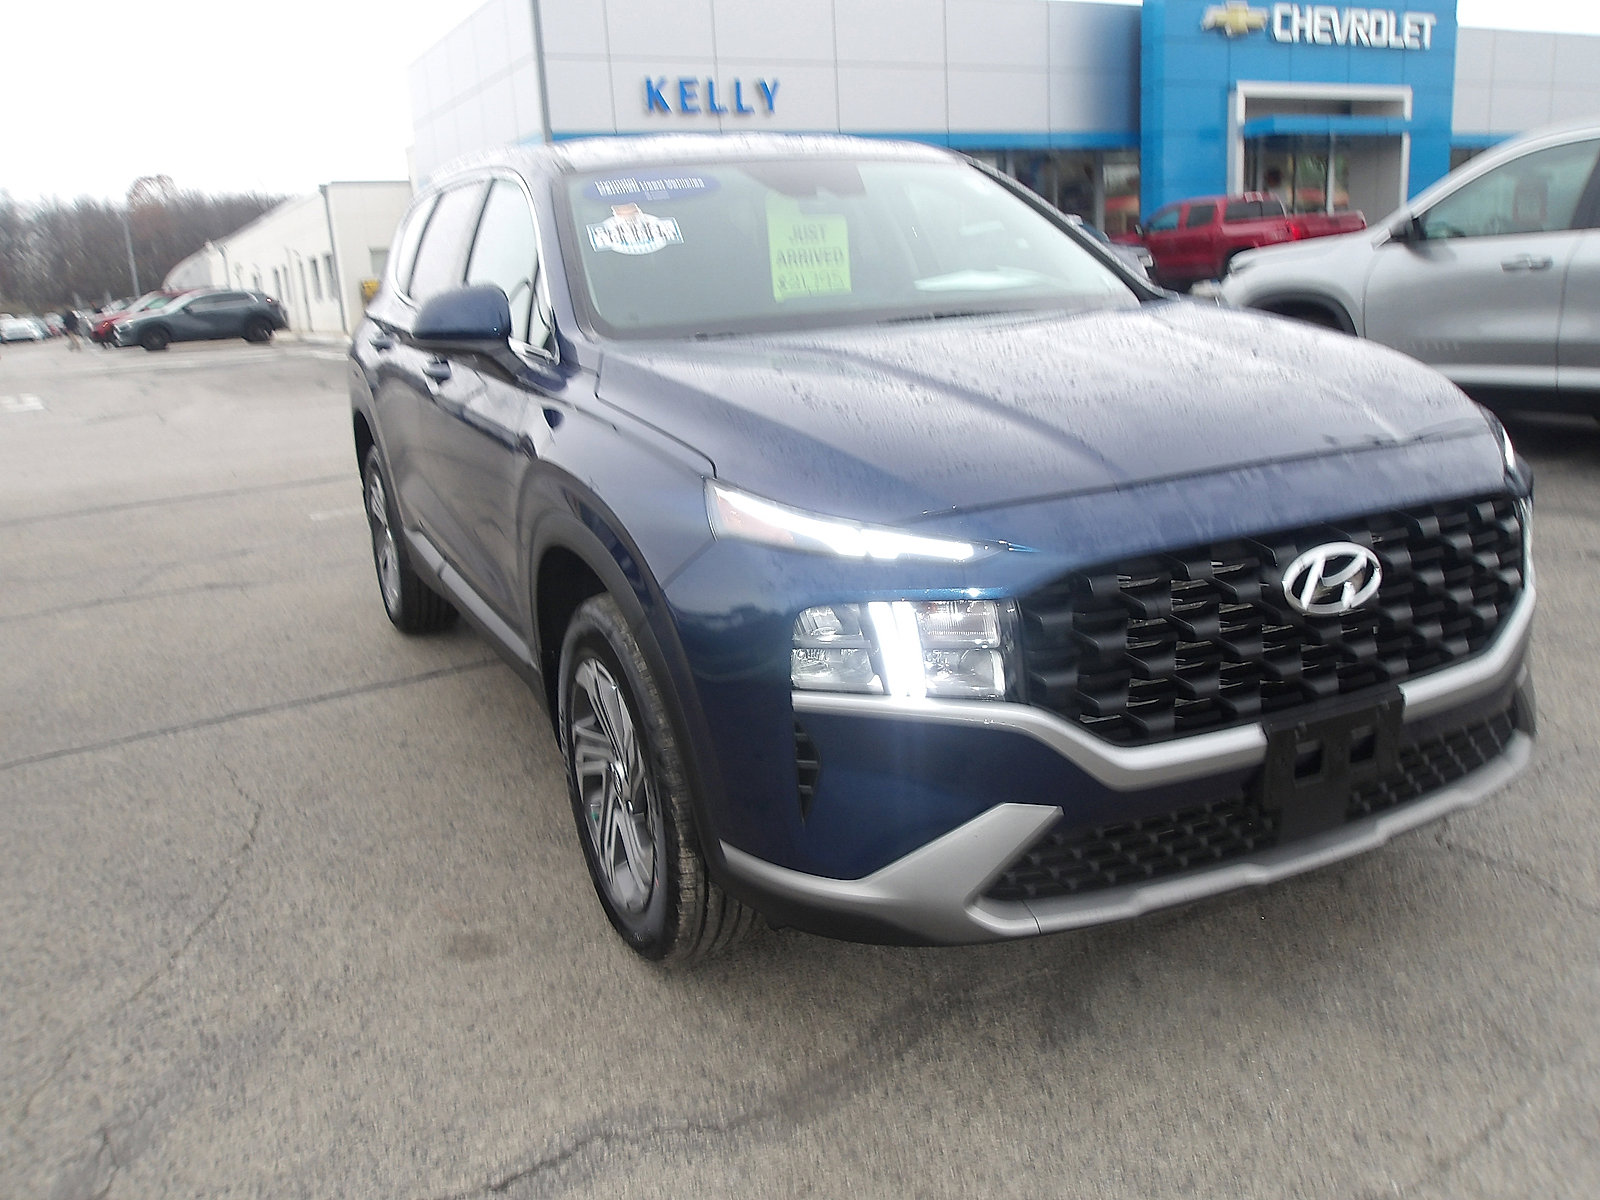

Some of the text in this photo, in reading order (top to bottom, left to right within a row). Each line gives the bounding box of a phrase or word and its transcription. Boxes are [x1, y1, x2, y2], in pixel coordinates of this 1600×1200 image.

[1273, 2, 1437, 49] CHEVROLET
[644, 75, 780, 115] KELLY
[788, 223, 827, 243] JUST
[776, 247, 845, 266] ARRIVED
